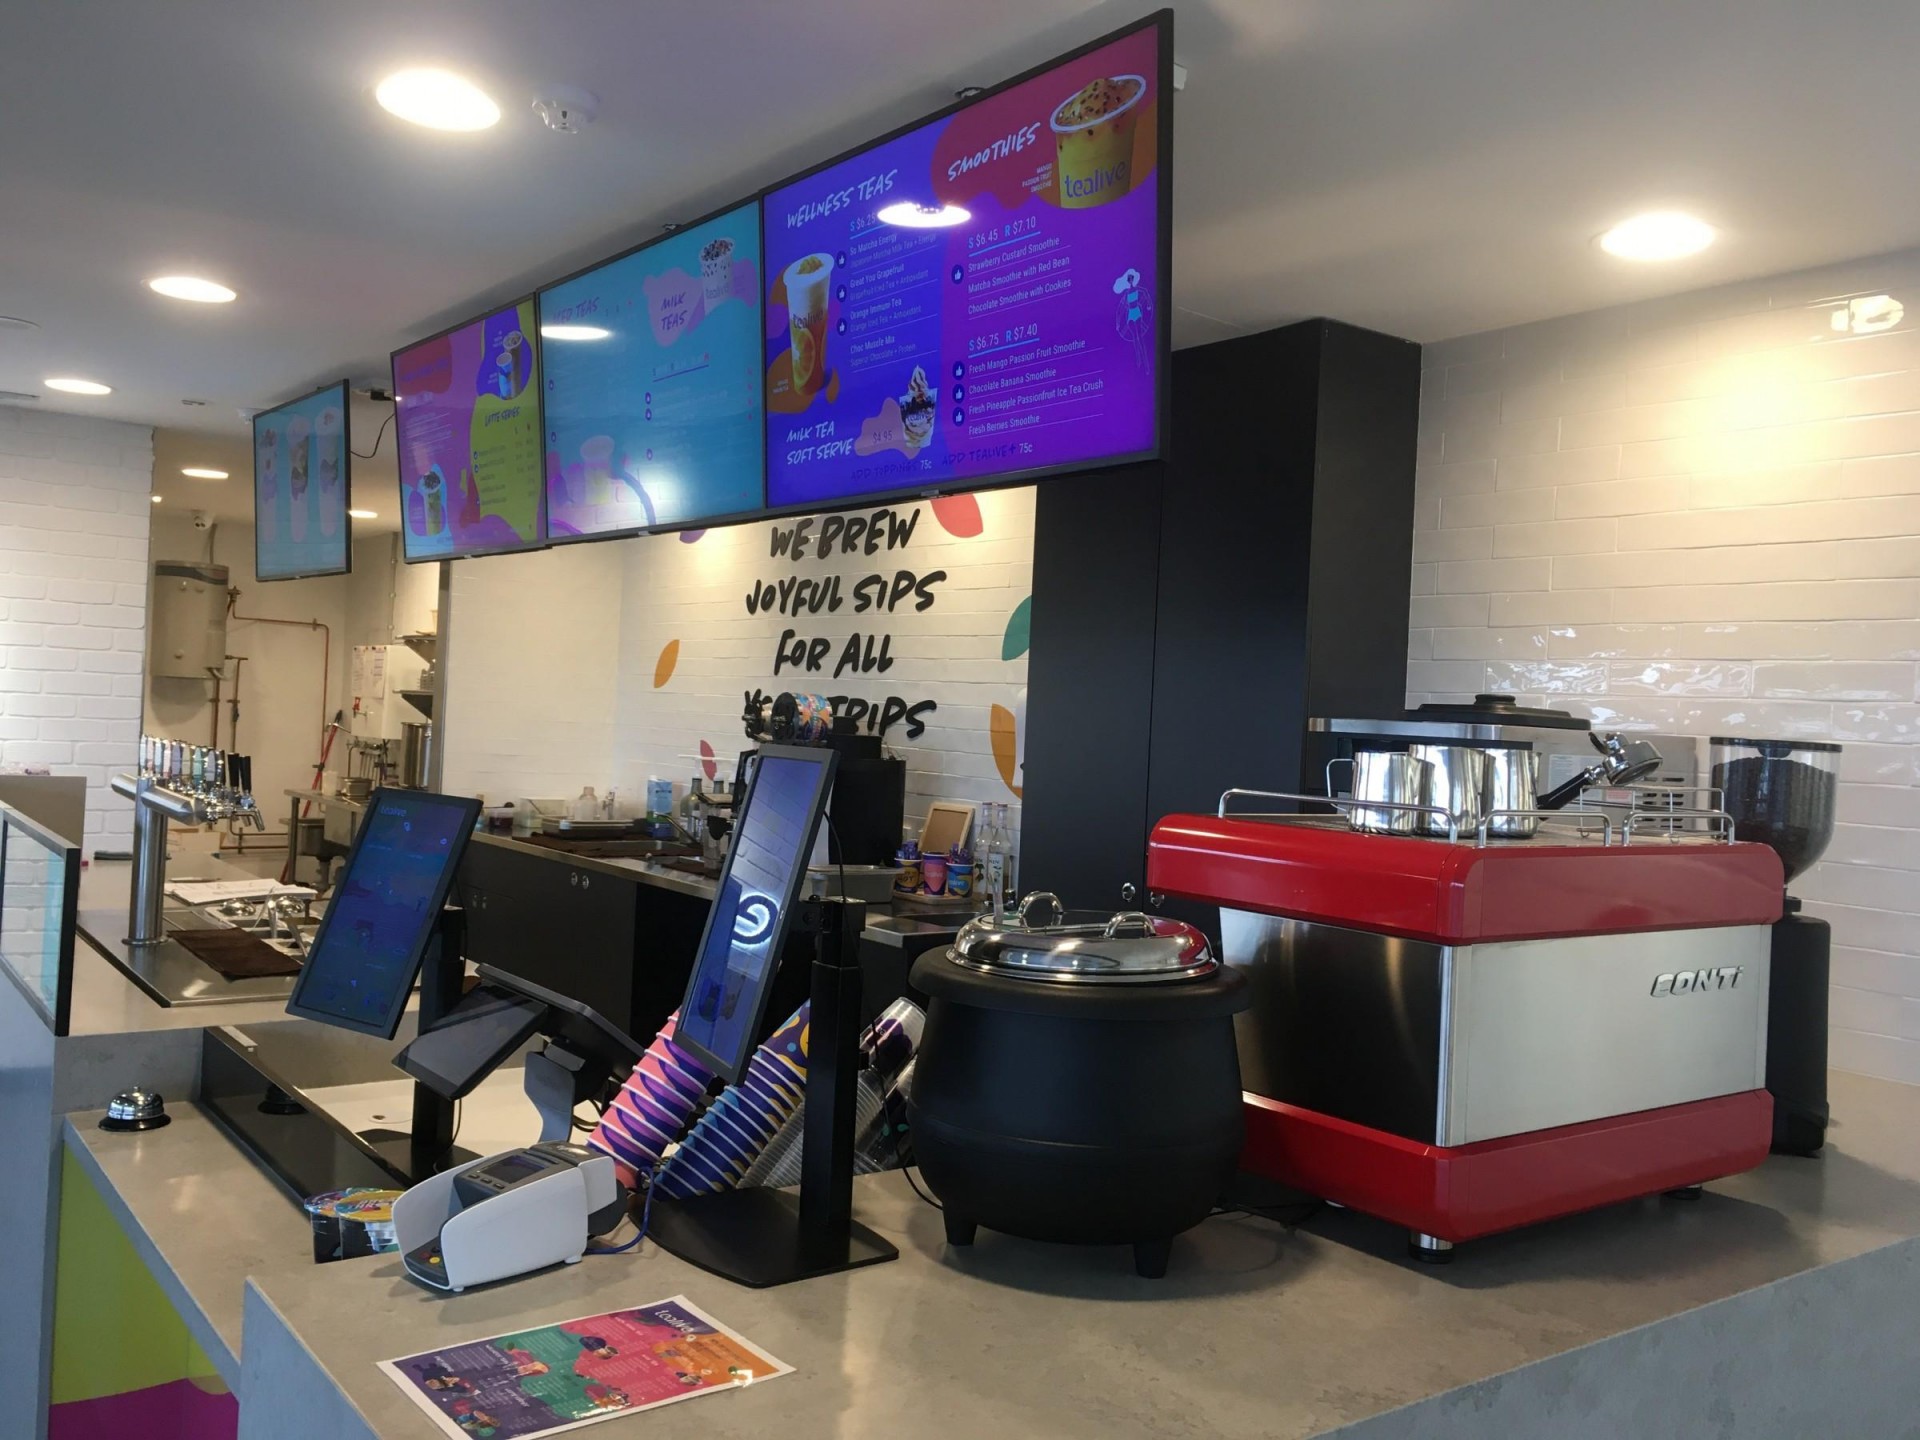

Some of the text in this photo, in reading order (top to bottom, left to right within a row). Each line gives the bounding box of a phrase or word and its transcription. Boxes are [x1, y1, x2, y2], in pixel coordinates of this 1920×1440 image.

[947, 122, 1041, 181] SMOOTHIES
[1064, 160, 1128, 199] tealive
[787, 169, 898, 229] WELLNESS TEAS
[968, 216, 1036, 248] S $6.45 R $7.10
[968, 236, 1060, 273] Strawberry Custard Smoothie
[968, 256, 1070, 294] Matcha Smoothie with Red Bean
[661, 292, 686, 310] MILK
[968, 278, 1072, 314] Chocolate Smoothie with Cookies
[661, 310, 688, 330] TEAS
[968, 322, 1038, 350] S $6.75 R $7.40
[968, 340, 1086, 374] Fresh Mango Passion Fruit Smoothie
[968, 367, 1056, 394] Chocolate Banana Smoothie
[968, 400, 986, 416] Fresh
[986, 394, 1016, 411] Pineapple
[1057, 384, 1068, 396] Ice
[1069, 382, 1082, 394] Tea
[1083, 378, 1104, 392] Crush
[786, 420, 834, 443] MILK TEA
[968, 414, 1040, 436] Fresh Berries Smoothie
[786, 438, 854, 465] SOFT SERVE
[920, 460, 932, 470] 75c
[1018, 442, 1033, 454] 75c
[770, 508, 921, 562] WE BREW
[746, 570, 947, 618] JOYFUL SIPS
[774, 629, 894, 679] FOR ALL
